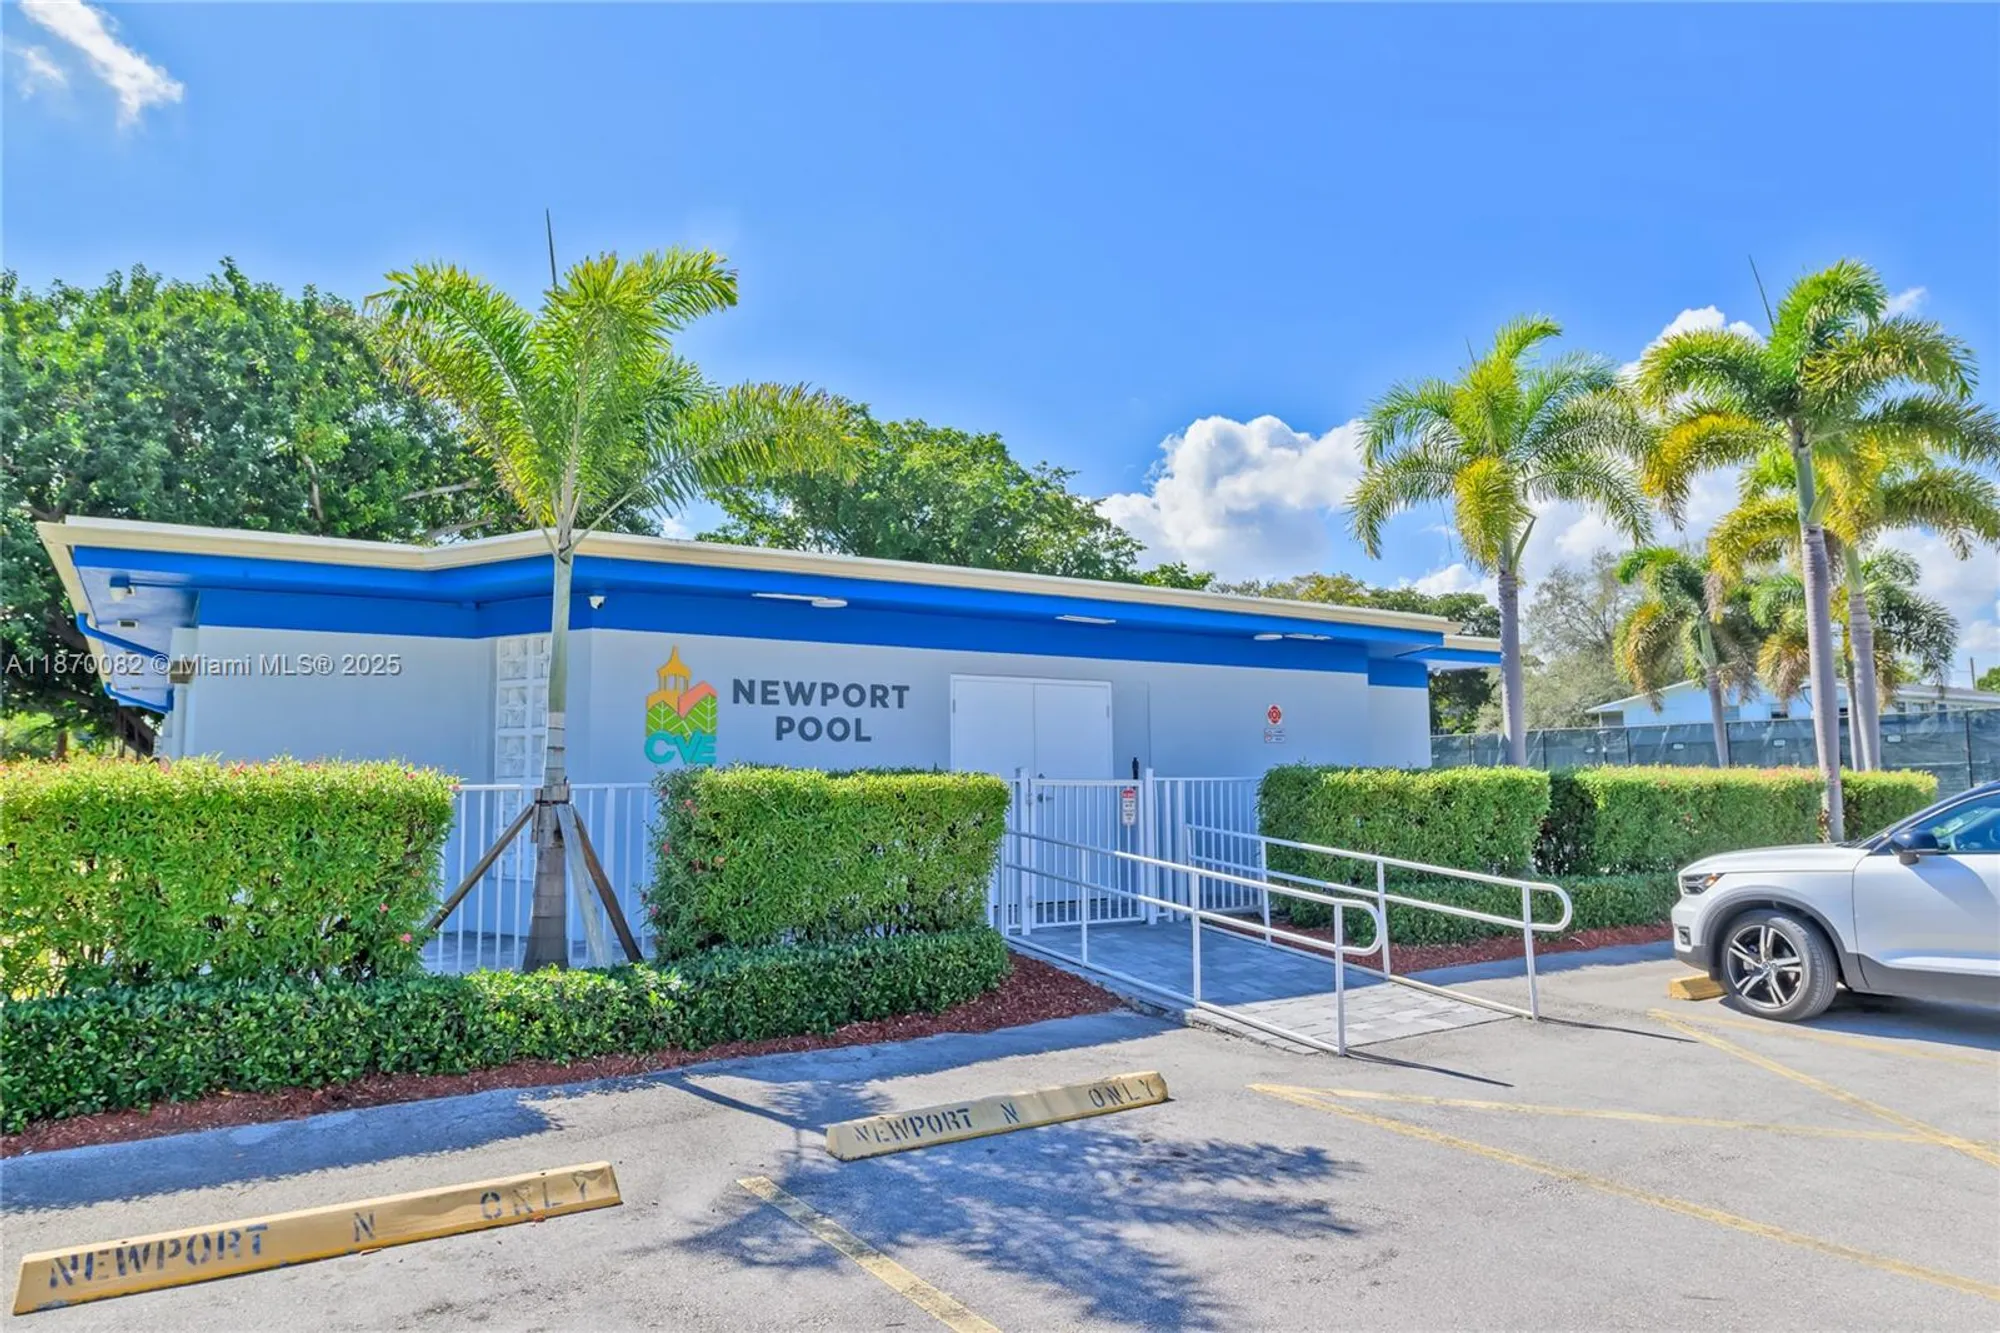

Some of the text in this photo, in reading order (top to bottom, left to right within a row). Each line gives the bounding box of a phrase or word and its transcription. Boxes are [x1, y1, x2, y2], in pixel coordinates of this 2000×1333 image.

[732, 678, 910, 709] NEWPORT
[775, 715, 872, 743] POOL
[644, 730, 717, 765] CVE
[854, 1077, 1153, 1145] NEWPORT N ONLY
[49, 1170, 601, 1289] NEWPORT N ONLY
